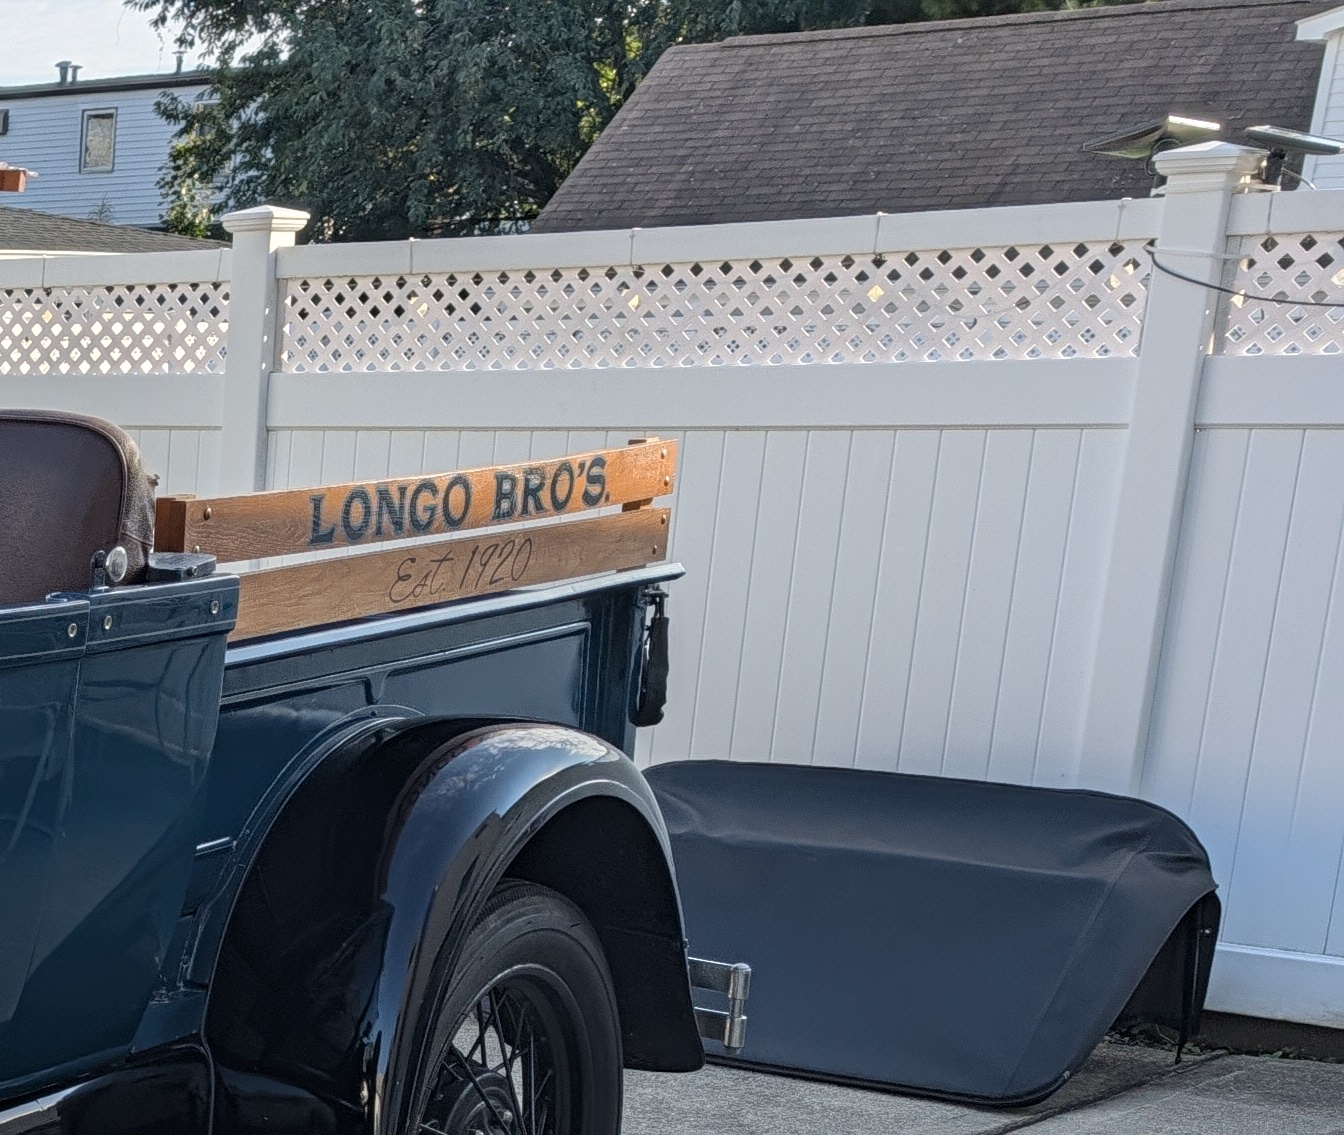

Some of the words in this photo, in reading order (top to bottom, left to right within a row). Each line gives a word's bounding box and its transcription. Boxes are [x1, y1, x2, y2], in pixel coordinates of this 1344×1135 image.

[308, 474, 472, 545] LONGO
[389, 550, 454, 603] Est.
[460, 537, 532, 590] 1920
